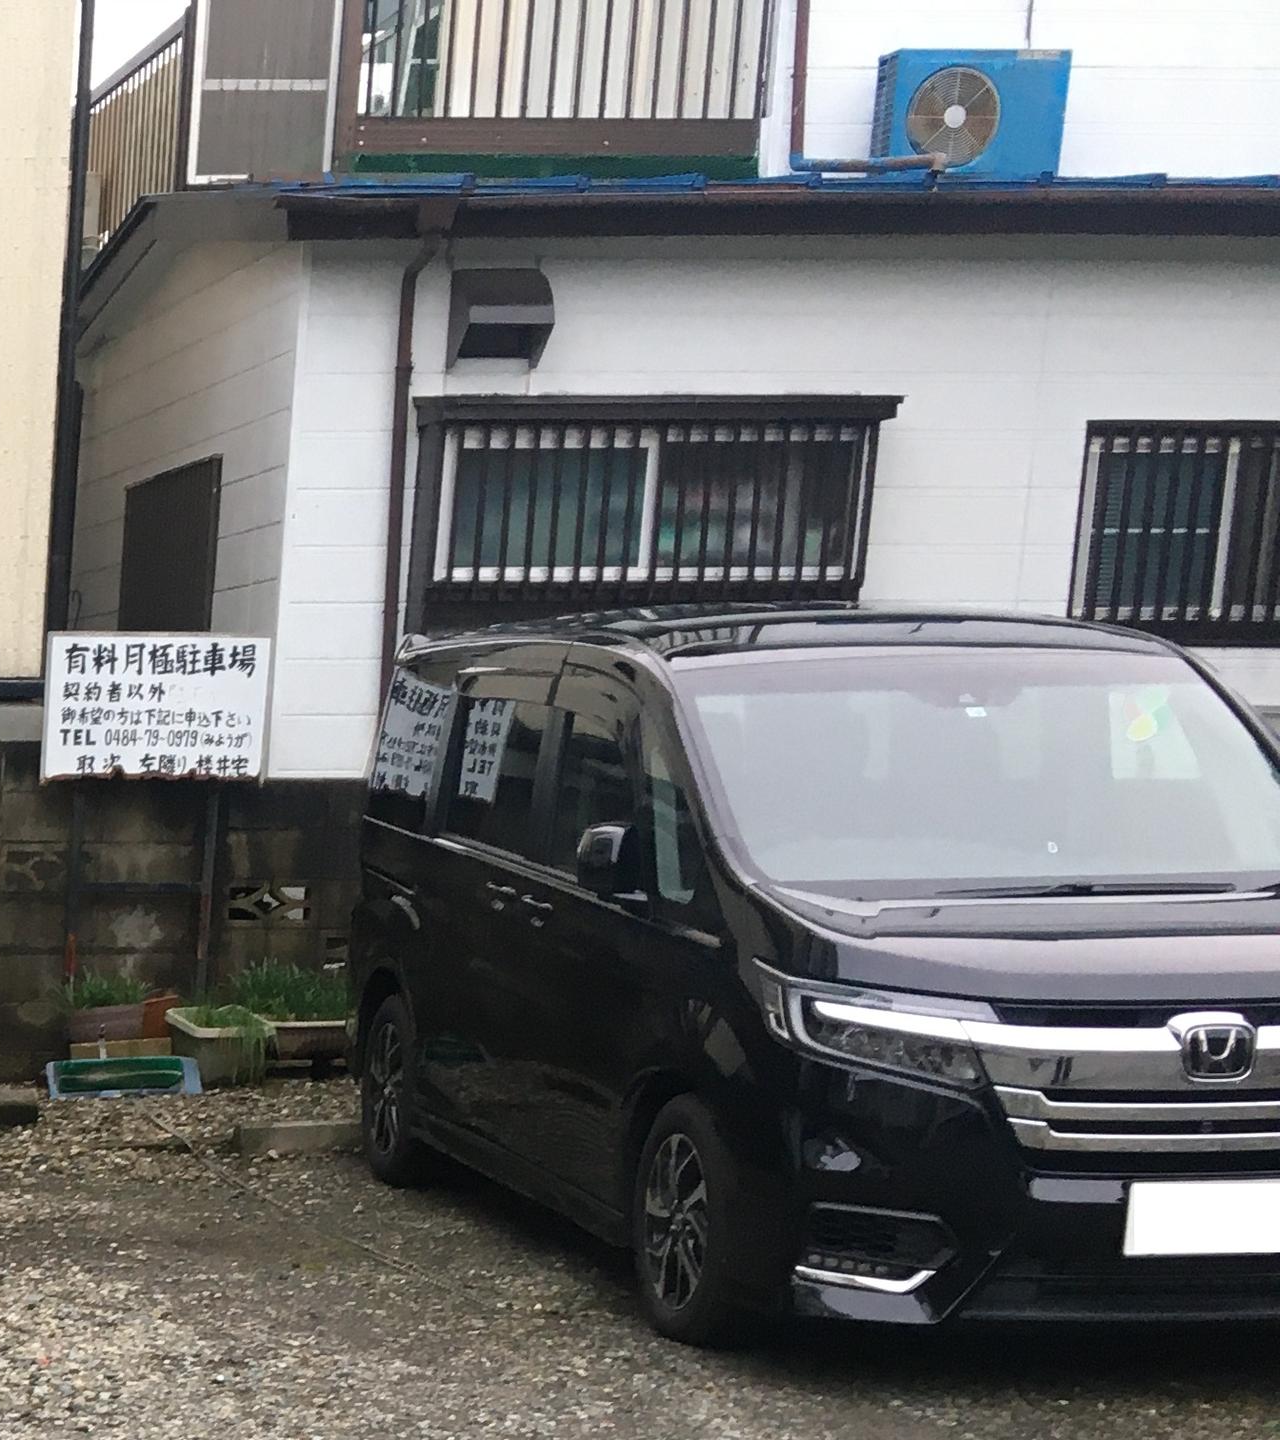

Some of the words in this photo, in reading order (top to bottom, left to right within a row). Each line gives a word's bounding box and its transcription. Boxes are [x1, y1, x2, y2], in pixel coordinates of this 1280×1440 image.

[65, 642, 257, 678] 有料月極駐車場
[63, 681, 166, 702] 契約者以外
[61, 706, 252, 728] 御希望の方は下記に申込下さい
[60, 729, 96, 746] TEL
